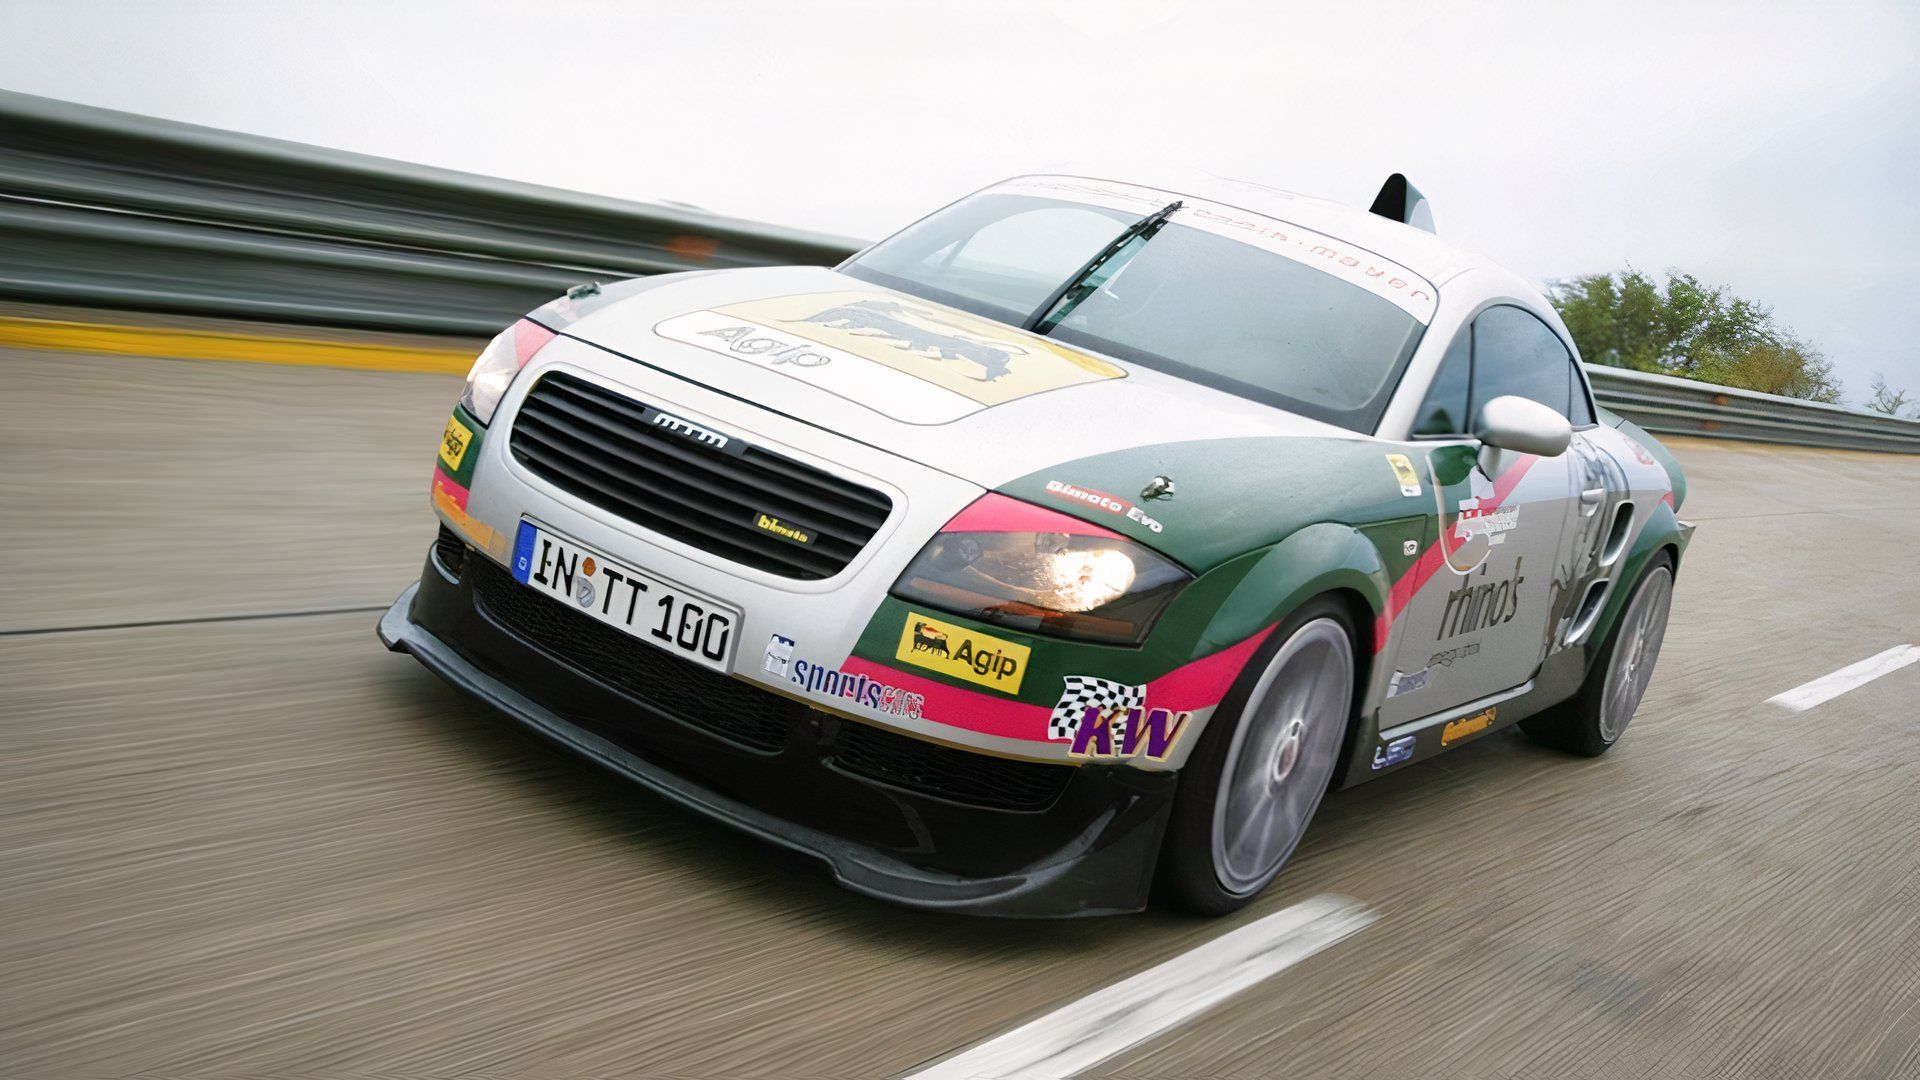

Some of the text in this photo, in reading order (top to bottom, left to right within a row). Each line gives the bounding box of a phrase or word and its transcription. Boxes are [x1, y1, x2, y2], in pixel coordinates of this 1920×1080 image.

[1126, 506, 1163, 533] Evo
[533, 538, 579, 598] IN
[602, 567, 648, 626] TT
[953, 639, 1018, 680] Agip
[1067, 705, 1193, 763] KW
